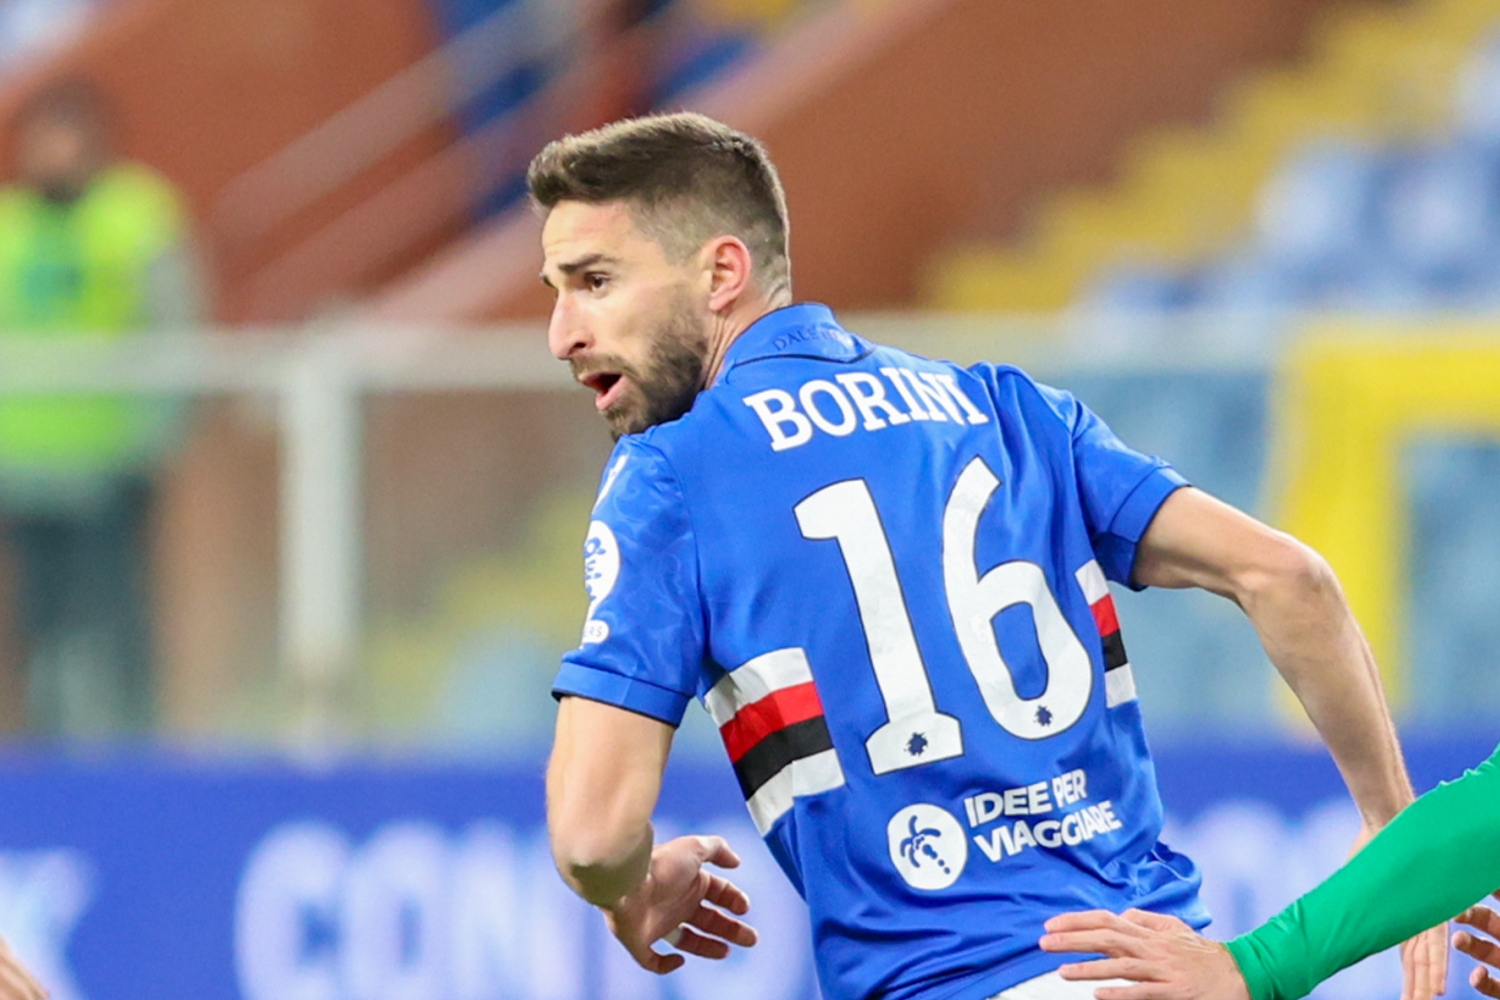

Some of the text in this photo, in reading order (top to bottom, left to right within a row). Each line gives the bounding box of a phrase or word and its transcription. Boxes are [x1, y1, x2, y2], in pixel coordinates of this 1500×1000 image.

[742, 366, 990, 452] BORINI
[792, 453, 1094, 776] 16
[964, 768, 1087, 828] IDEE PER
[973, 800, 1123, 863] VIAGGIARE
